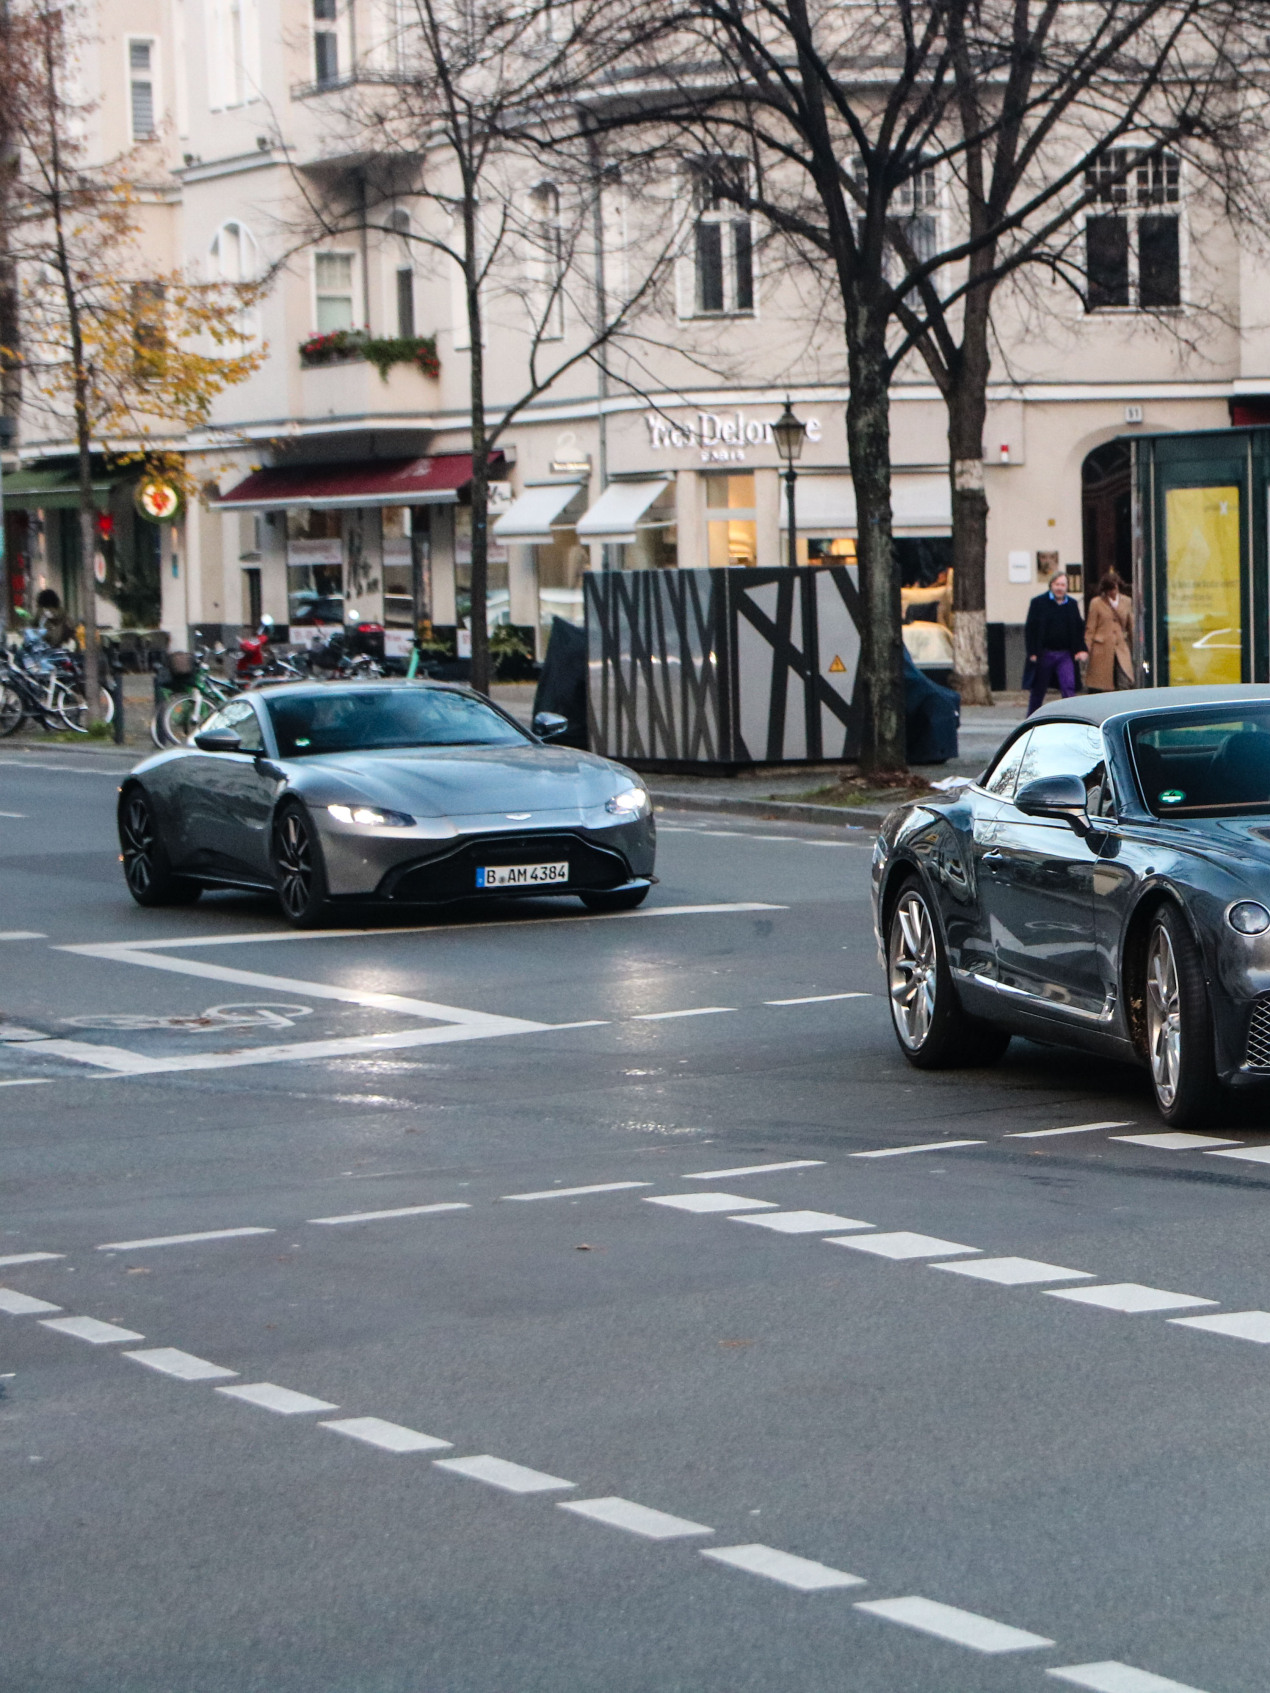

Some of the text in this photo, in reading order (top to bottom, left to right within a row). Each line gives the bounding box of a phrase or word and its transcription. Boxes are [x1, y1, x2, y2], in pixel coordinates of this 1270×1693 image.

[699, 411, 822, 447] Delore
[486, 870, 496, 884] B
[507, 868, 527, 883] AM
[530, 865, 566, 881] 4384
